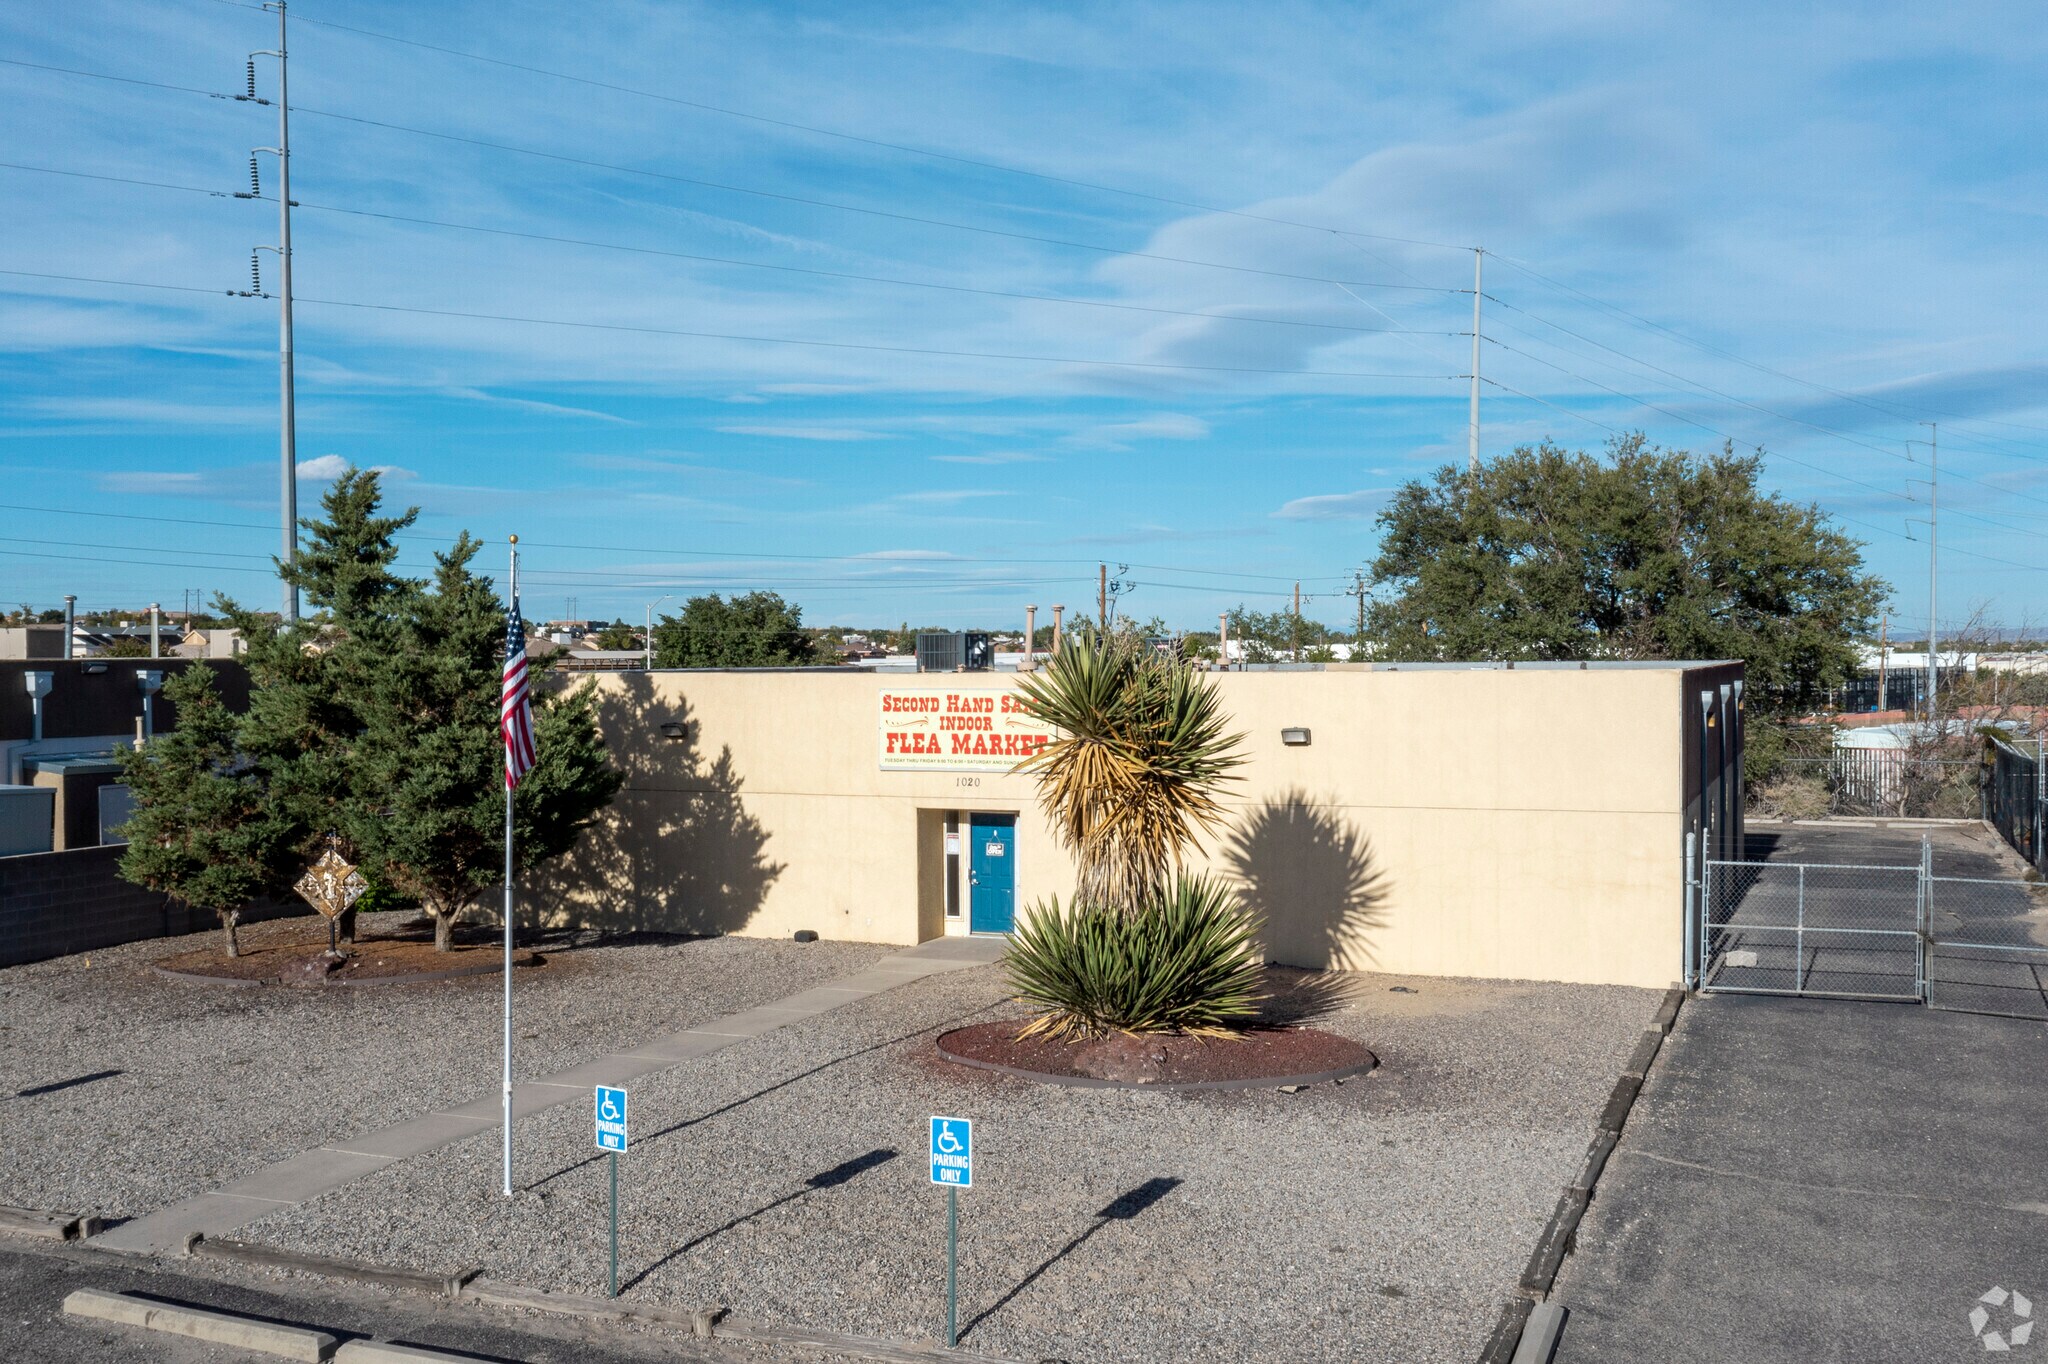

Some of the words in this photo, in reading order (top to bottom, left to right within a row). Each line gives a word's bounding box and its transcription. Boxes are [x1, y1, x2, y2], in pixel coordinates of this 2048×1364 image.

[883, 695, 940, 712] SECOND
[946, 694, 994, 713] HAND
[940, 716, 993, 731] INDOOR
[886, 732, 942, 754] FLEA
[952, 734, 1048, 756] MARKET
[956, 777, 980, 787] 1020
[599, 1120, 624, 1135] PARKING
[603, 1134, 619, 1147] ONLY
[933, 1153, 968, 1168] PARKING
[940, 1168, 961, 1182] ONLY
